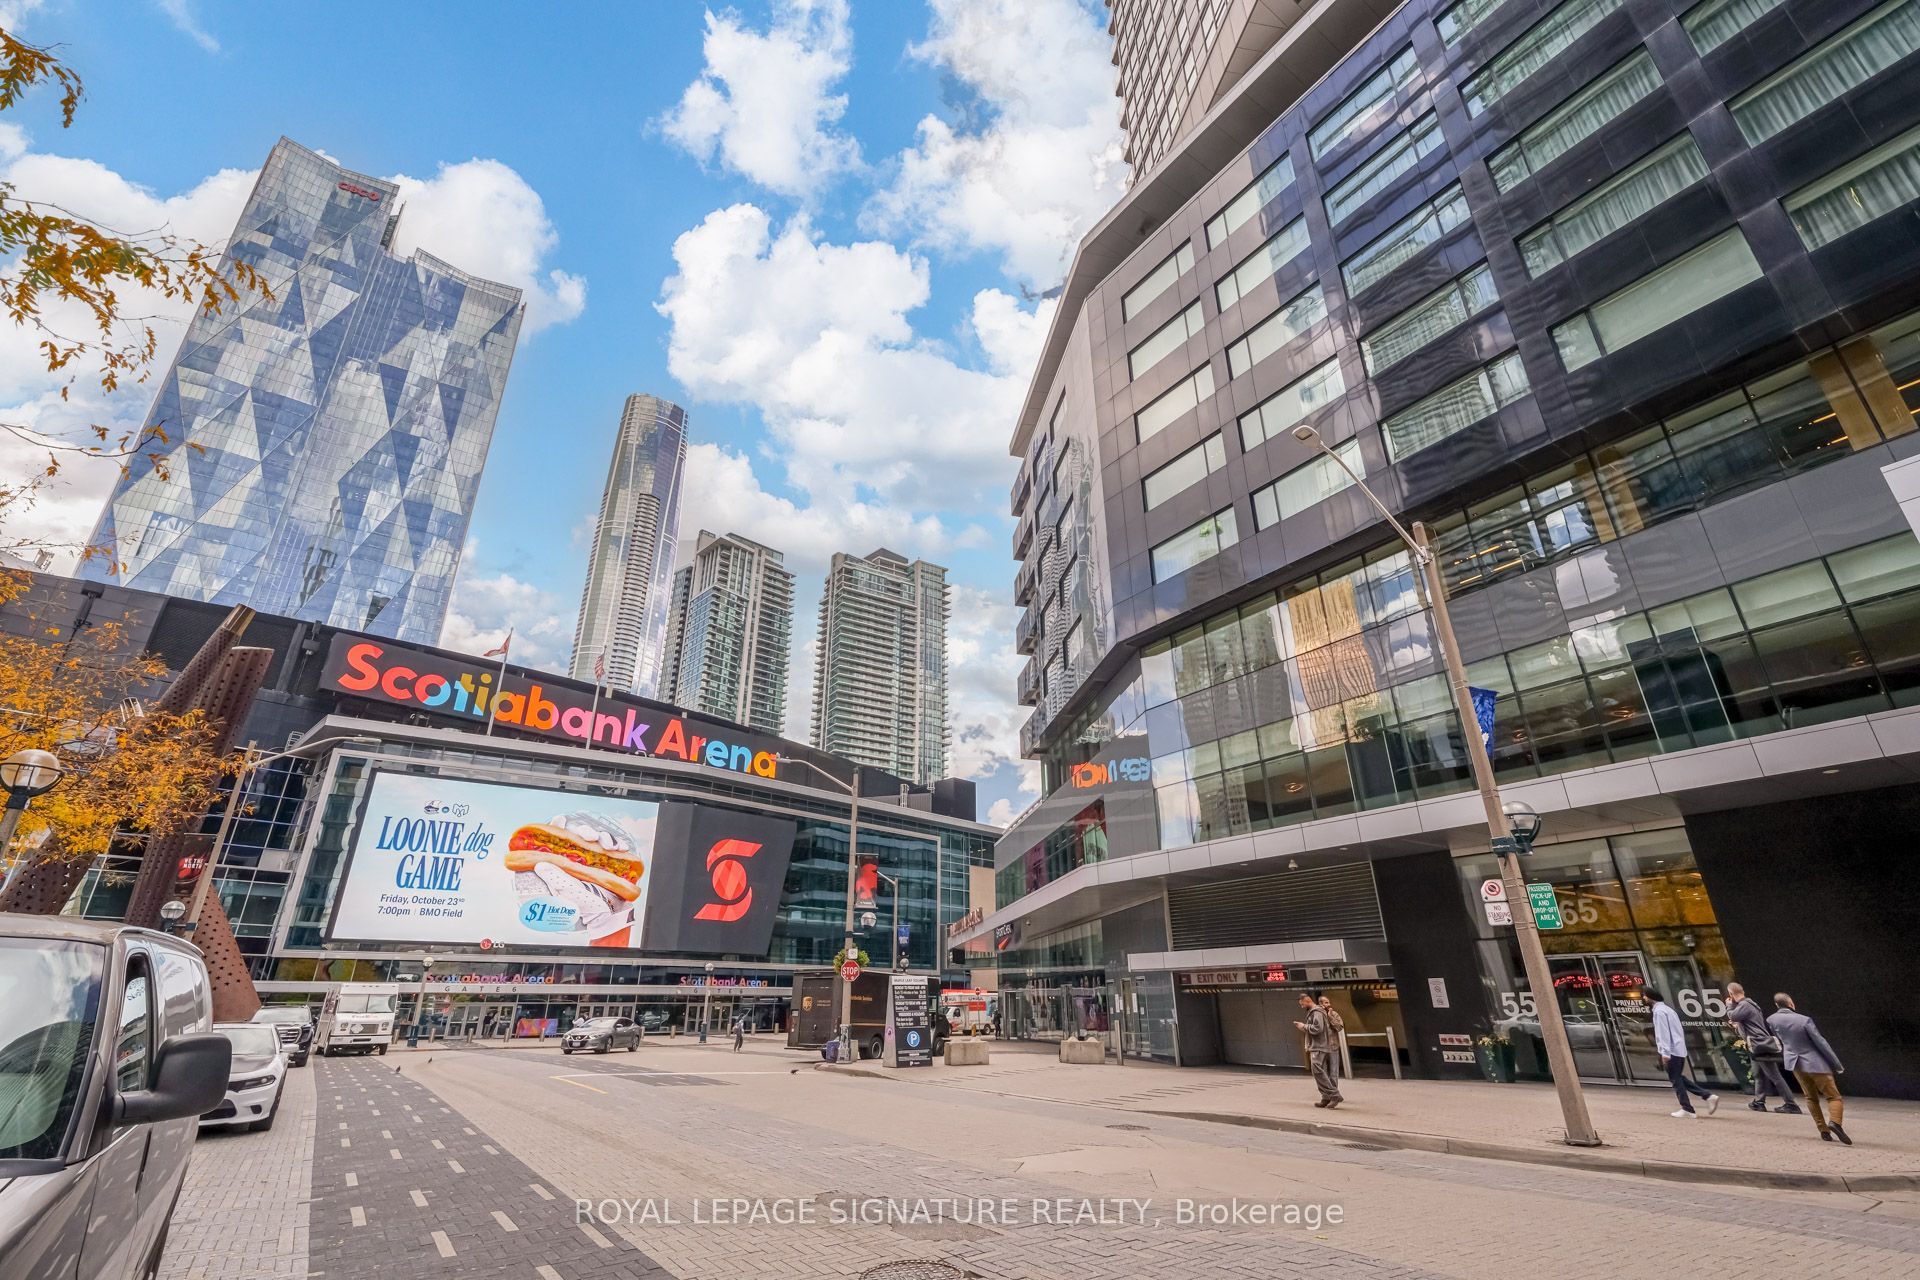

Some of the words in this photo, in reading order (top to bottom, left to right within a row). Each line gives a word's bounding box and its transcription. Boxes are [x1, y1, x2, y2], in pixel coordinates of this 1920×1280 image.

[337, 643, 651, 751] Scotiabank
[654, 719, 777, 779] Arena
[376, 816, 465, 855] LOONIE
[463, 822, 495, 860] dog
[396, 854, 465, 891] GAME
[380, 893, 409, 905] Friday,
[411, 895, 446, 906] October
[377, 906, 411, 916] 7:00pm
[419, 907, 441, 917] BMO
[442, 908, 463, 918] Field
[525, 902, 547, 922] $1
[547, 905, 560, 914] Hot
[560, 906, 576, 916] Dogs
[1559, 898, 1598, 925] 65
[426, 972, 508, 984] Scotiabank
[512, 973, 555, 984] Arena
[842, 966, 858, 975] STOP
[1197, 973, 1216, 984] EXIT
[1217, 972, 1239, 983] ONLY
[1321, 967, 1359, 979] ENTER
[739, 977, 769, 987] Arena
[1501, 991, 1538, 1017] 55
[1678, 988, 1728, 1018] 65
